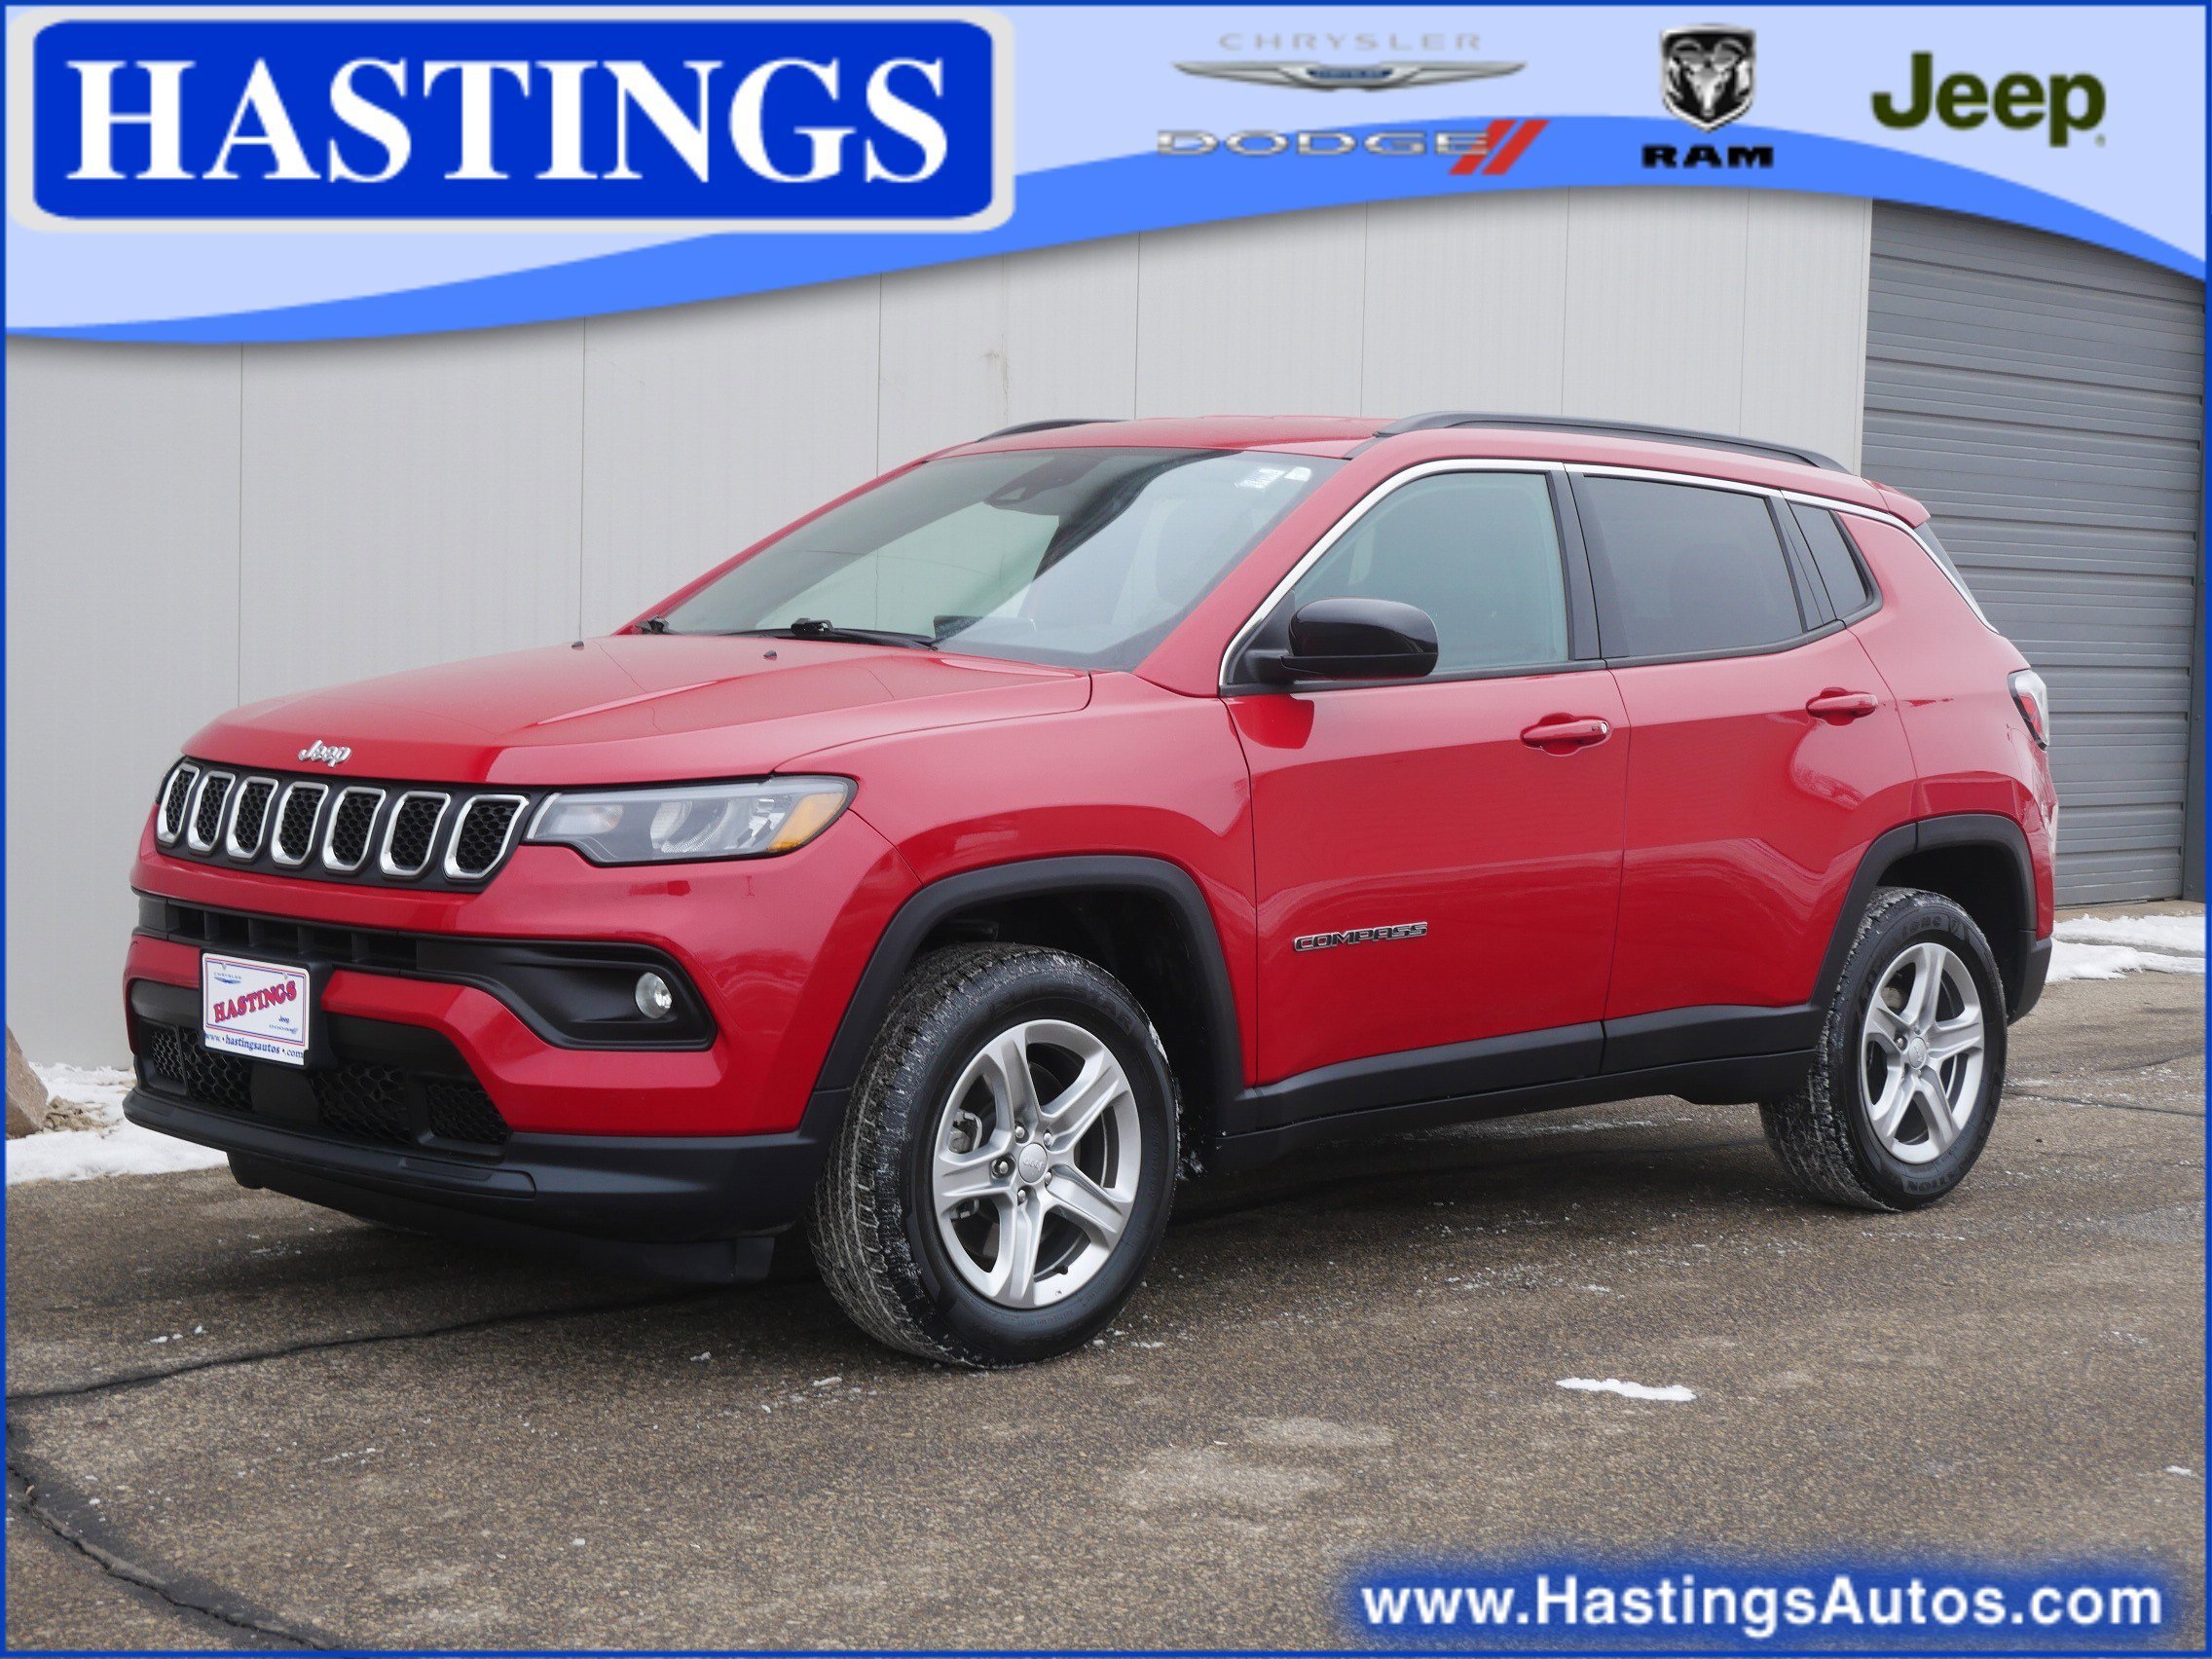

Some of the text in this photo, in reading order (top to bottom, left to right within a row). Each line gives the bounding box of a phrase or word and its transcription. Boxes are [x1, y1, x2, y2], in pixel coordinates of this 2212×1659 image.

[298, 739, 351, 768] Jeep
[1294, 922, 1428, 952] COMPASS
[213, 979, 297, 1023] HASTINGS
[226, 1034, 280, 1053] hastingsautos
